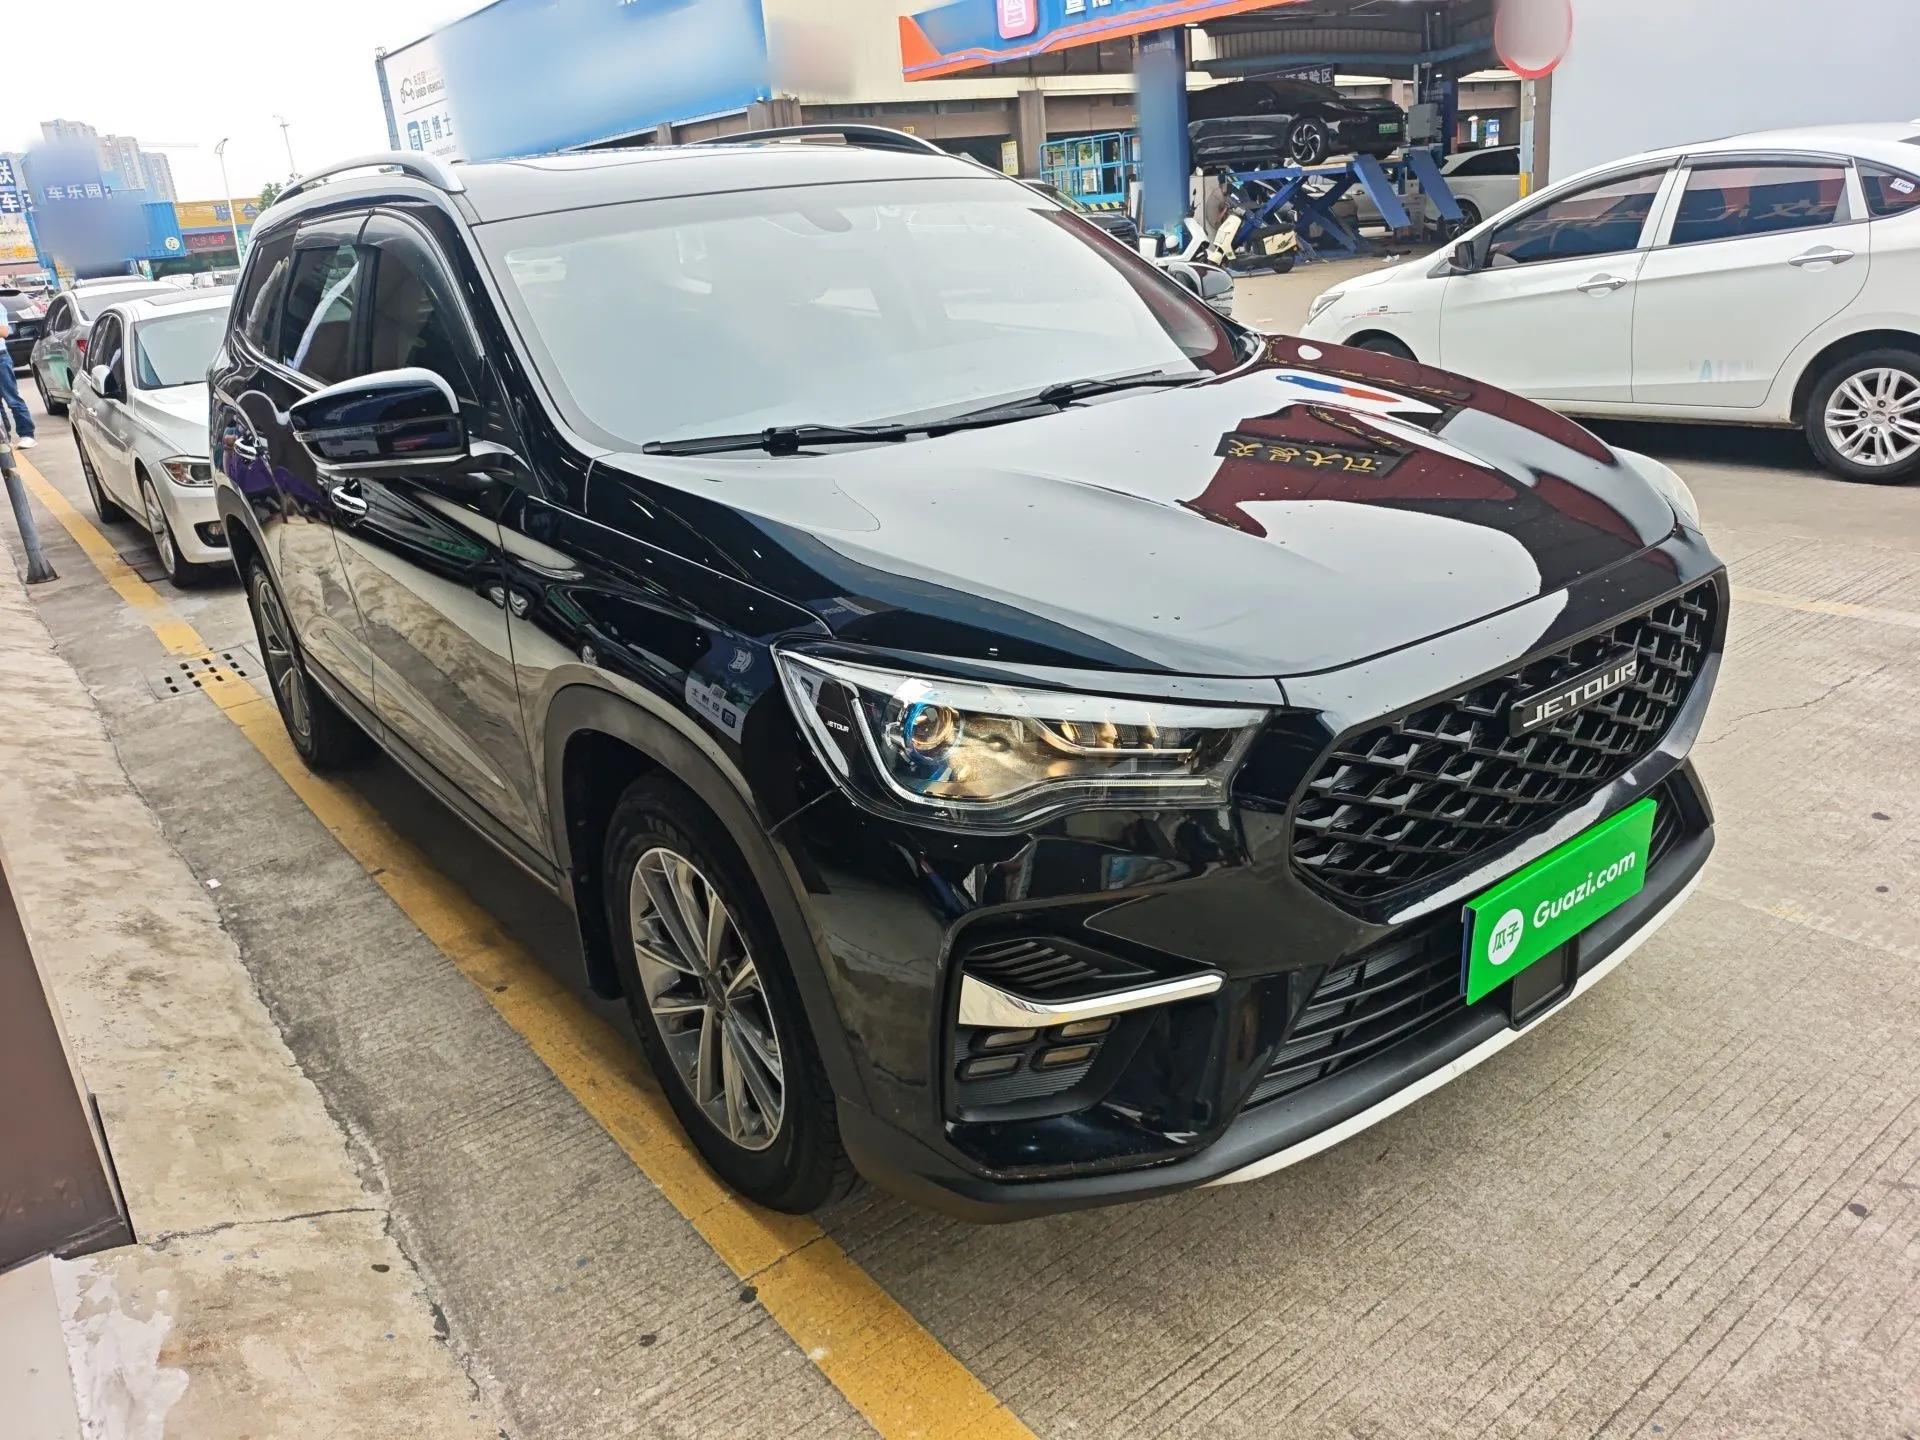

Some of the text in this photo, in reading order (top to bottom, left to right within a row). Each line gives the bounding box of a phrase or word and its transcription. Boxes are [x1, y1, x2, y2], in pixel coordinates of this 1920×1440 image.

[46, 184, 102, 200] 车乐园
[1523, 659, 1638, 728] JETOUR
[1492, 851, 1636, 954] 瓜子 Guazi.com
